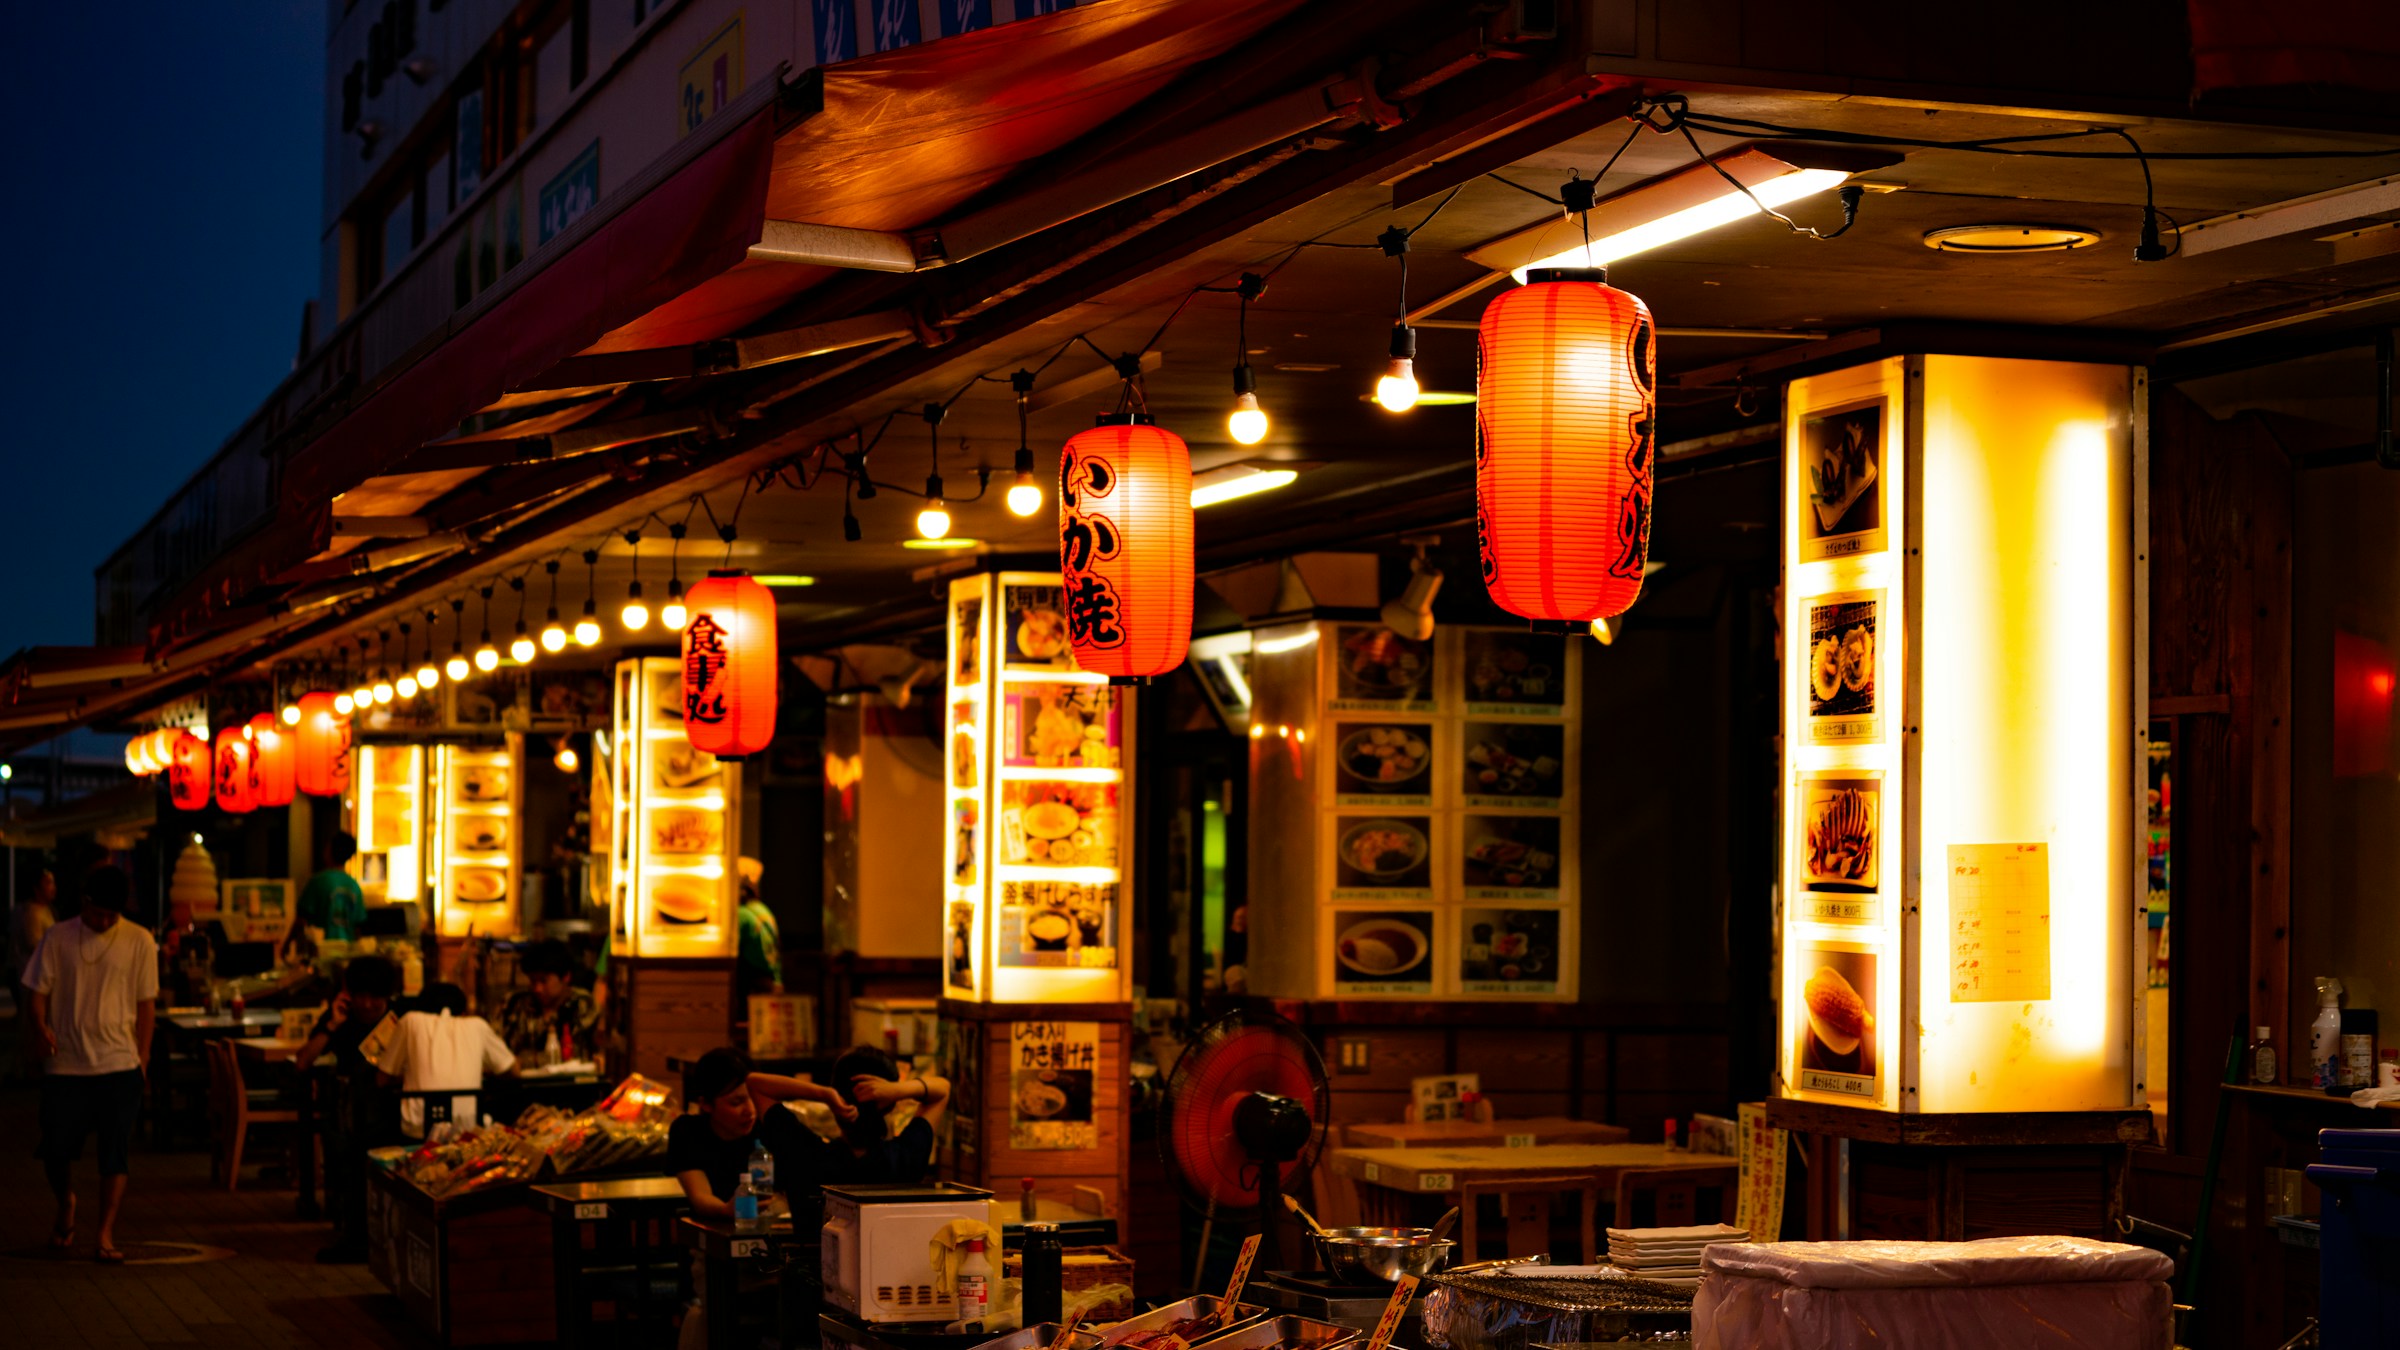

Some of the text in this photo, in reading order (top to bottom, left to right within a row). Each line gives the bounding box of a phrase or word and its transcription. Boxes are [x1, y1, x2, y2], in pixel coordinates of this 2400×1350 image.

[1061, 446, 1124, 648] いか焼
[686, 613, 728, 724] 食事処
[581, 1205, 600, 1218] D4
[1425, 1174, 1448, 1189] D2
